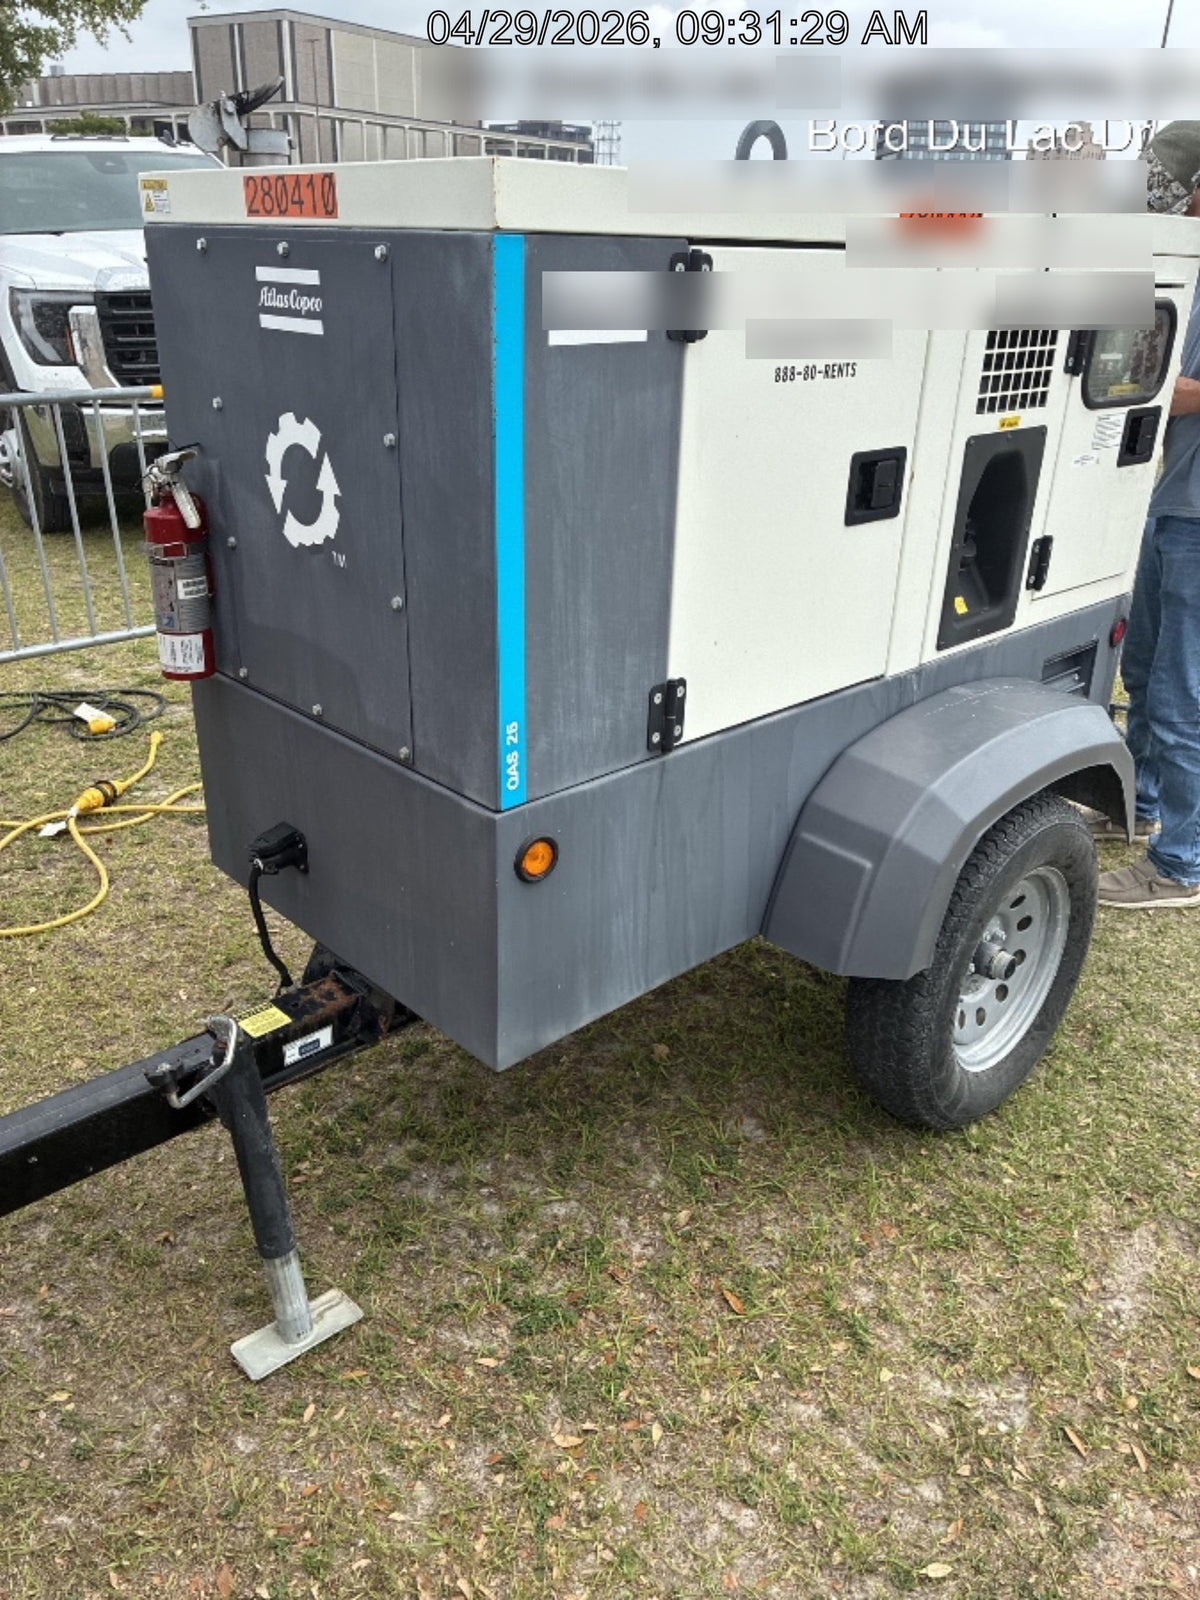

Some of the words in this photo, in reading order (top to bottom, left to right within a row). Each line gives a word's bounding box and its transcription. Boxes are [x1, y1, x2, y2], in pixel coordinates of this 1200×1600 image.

[246, 174, 336, 215] 280410
[774, 362, 858, 383] 888-80-RENTS
[506, 750, 519, 791] QAS
